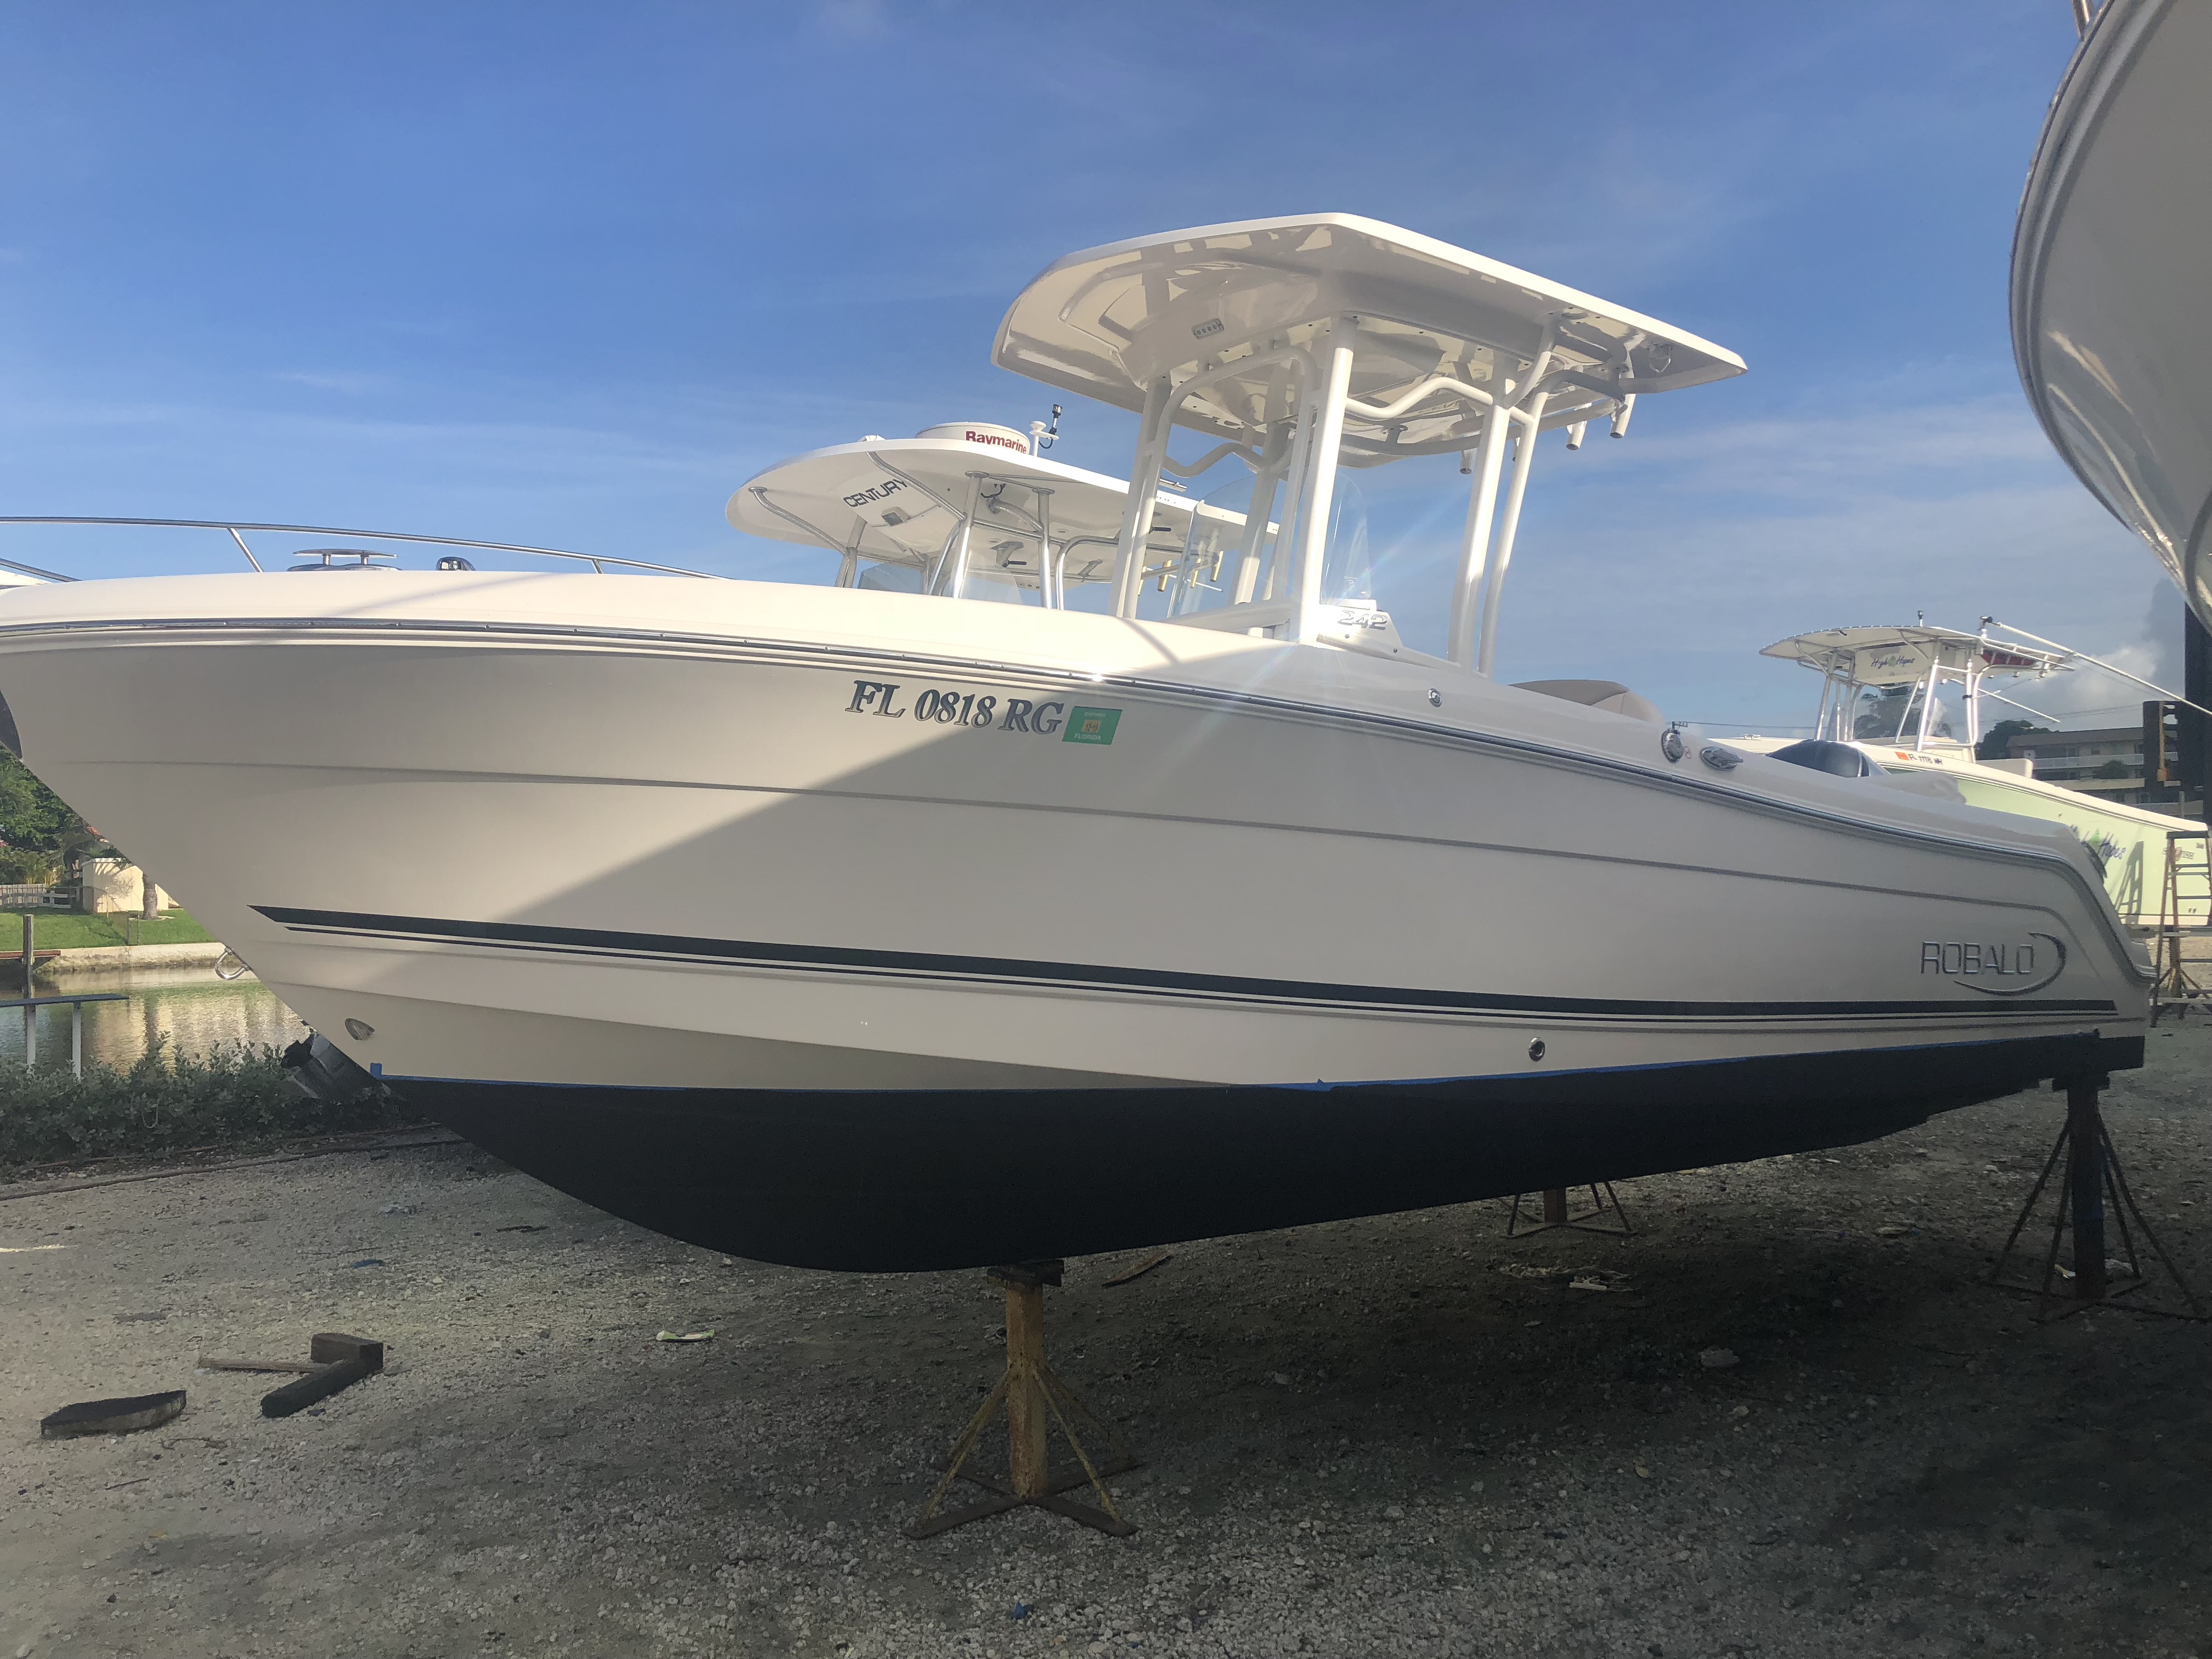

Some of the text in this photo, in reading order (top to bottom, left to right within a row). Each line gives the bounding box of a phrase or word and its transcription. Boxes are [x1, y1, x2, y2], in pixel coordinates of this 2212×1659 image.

[966, 430, 1026, 454] Raymarine
[843, 478, 908, 507] CENTURY
[1337, 610, 1389, 630] 242
[844, 680, 1065, 735] FL 0818 RG
[1074, 733, 1101, 741] FLORIDA
[1921, 940, 2034, 975] ROBALO
